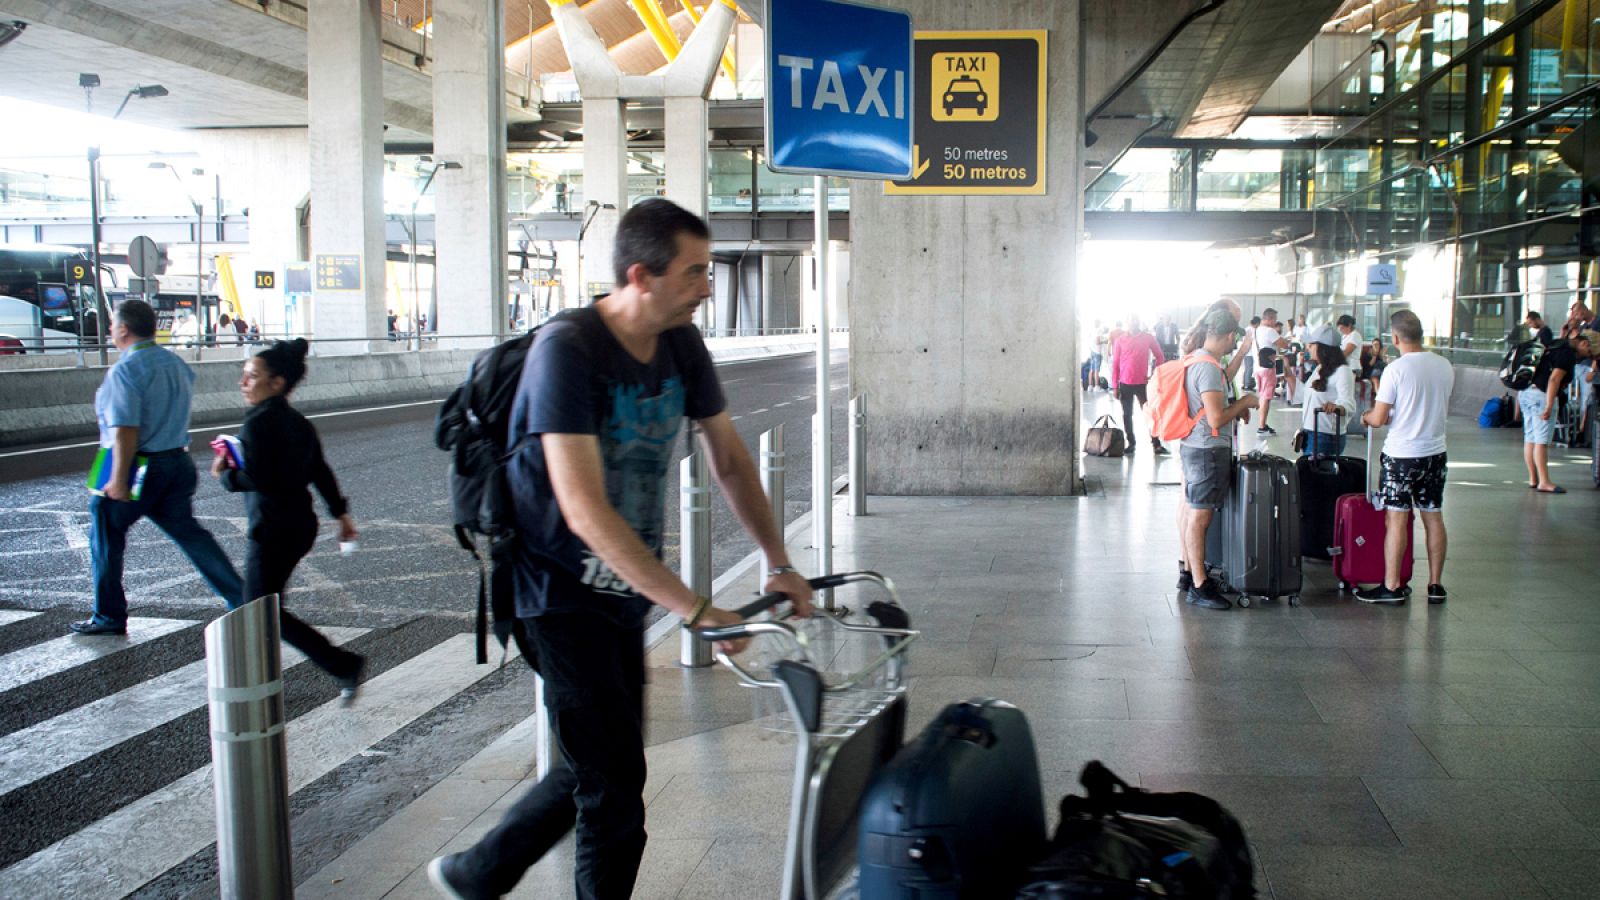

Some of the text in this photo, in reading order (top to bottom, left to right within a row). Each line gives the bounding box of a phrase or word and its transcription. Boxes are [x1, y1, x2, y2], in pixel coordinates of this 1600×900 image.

[945, 57, 986, 72] TAXI
[778, 54, 905, 120] TAXI
[944, 147, 1008, 161] 50 metres
[943, 163, 1027, 180] 50 metros
[73, 265, 85, 279] 9
[257, 275, 273, 286] 10
